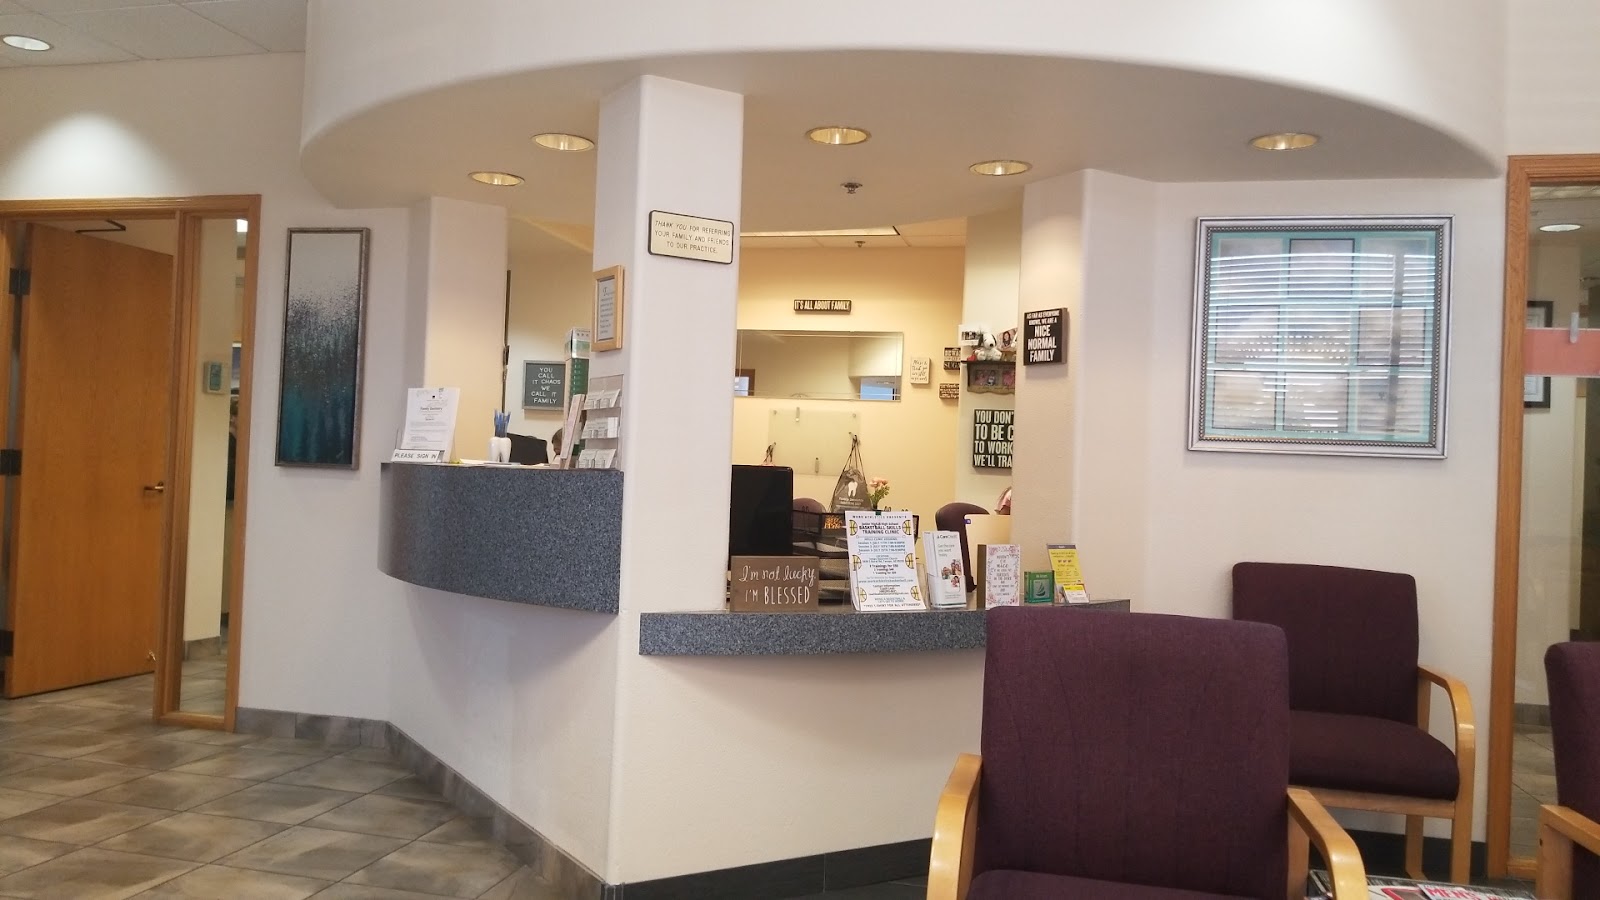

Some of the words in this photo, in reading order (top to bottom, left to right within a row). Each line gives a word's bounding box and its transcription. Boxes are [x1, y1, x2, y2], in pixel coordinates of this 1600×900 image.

[655, 220, 674, 228] THANK
[676, 223, 687, 231] YOU
[702, 226, 731, 237] REFERRING
[655, 229, 670, 238] YOUR
[672, 231, 693, 241] FAMILY
[708, 238, 730, 246] FRIENDS
[666, 240, 674, 248] TO
[676, 242, 688, 250] OUR
[794, 300, 804, 310] IT'S
[804, 300, 813, 310] ALL
[814, 300, 830, 310] ABOUT
[831, 300, 850, 310] FAMILY
[1034, 324, 1051, 338] NICE
[1027, 336, 1057, 350] NORMAL
[1029, 349, 1055, 362] FAMILY
[975, 410, 992, 423] YOU
[993, 411, 1014, 424] DON'
[975, 423, 988, 440] TO
[991, 424, 1005, 441] BE
[1007, 424, 1014, 441] C
[974, 440, 985, 454] TO
[987, 441, 1013, 455] WORK
[973, 454, 995, 467] WE'LL
[997, 455, 1012, 468] TRA
[739, 565, 759, 582] I'm
[762, 565, 780, 581] not
[783, 565, 816, 587] lucky
[745, 589, 758, 602] I'M
[764, 585, 810, 605] BLESSED
